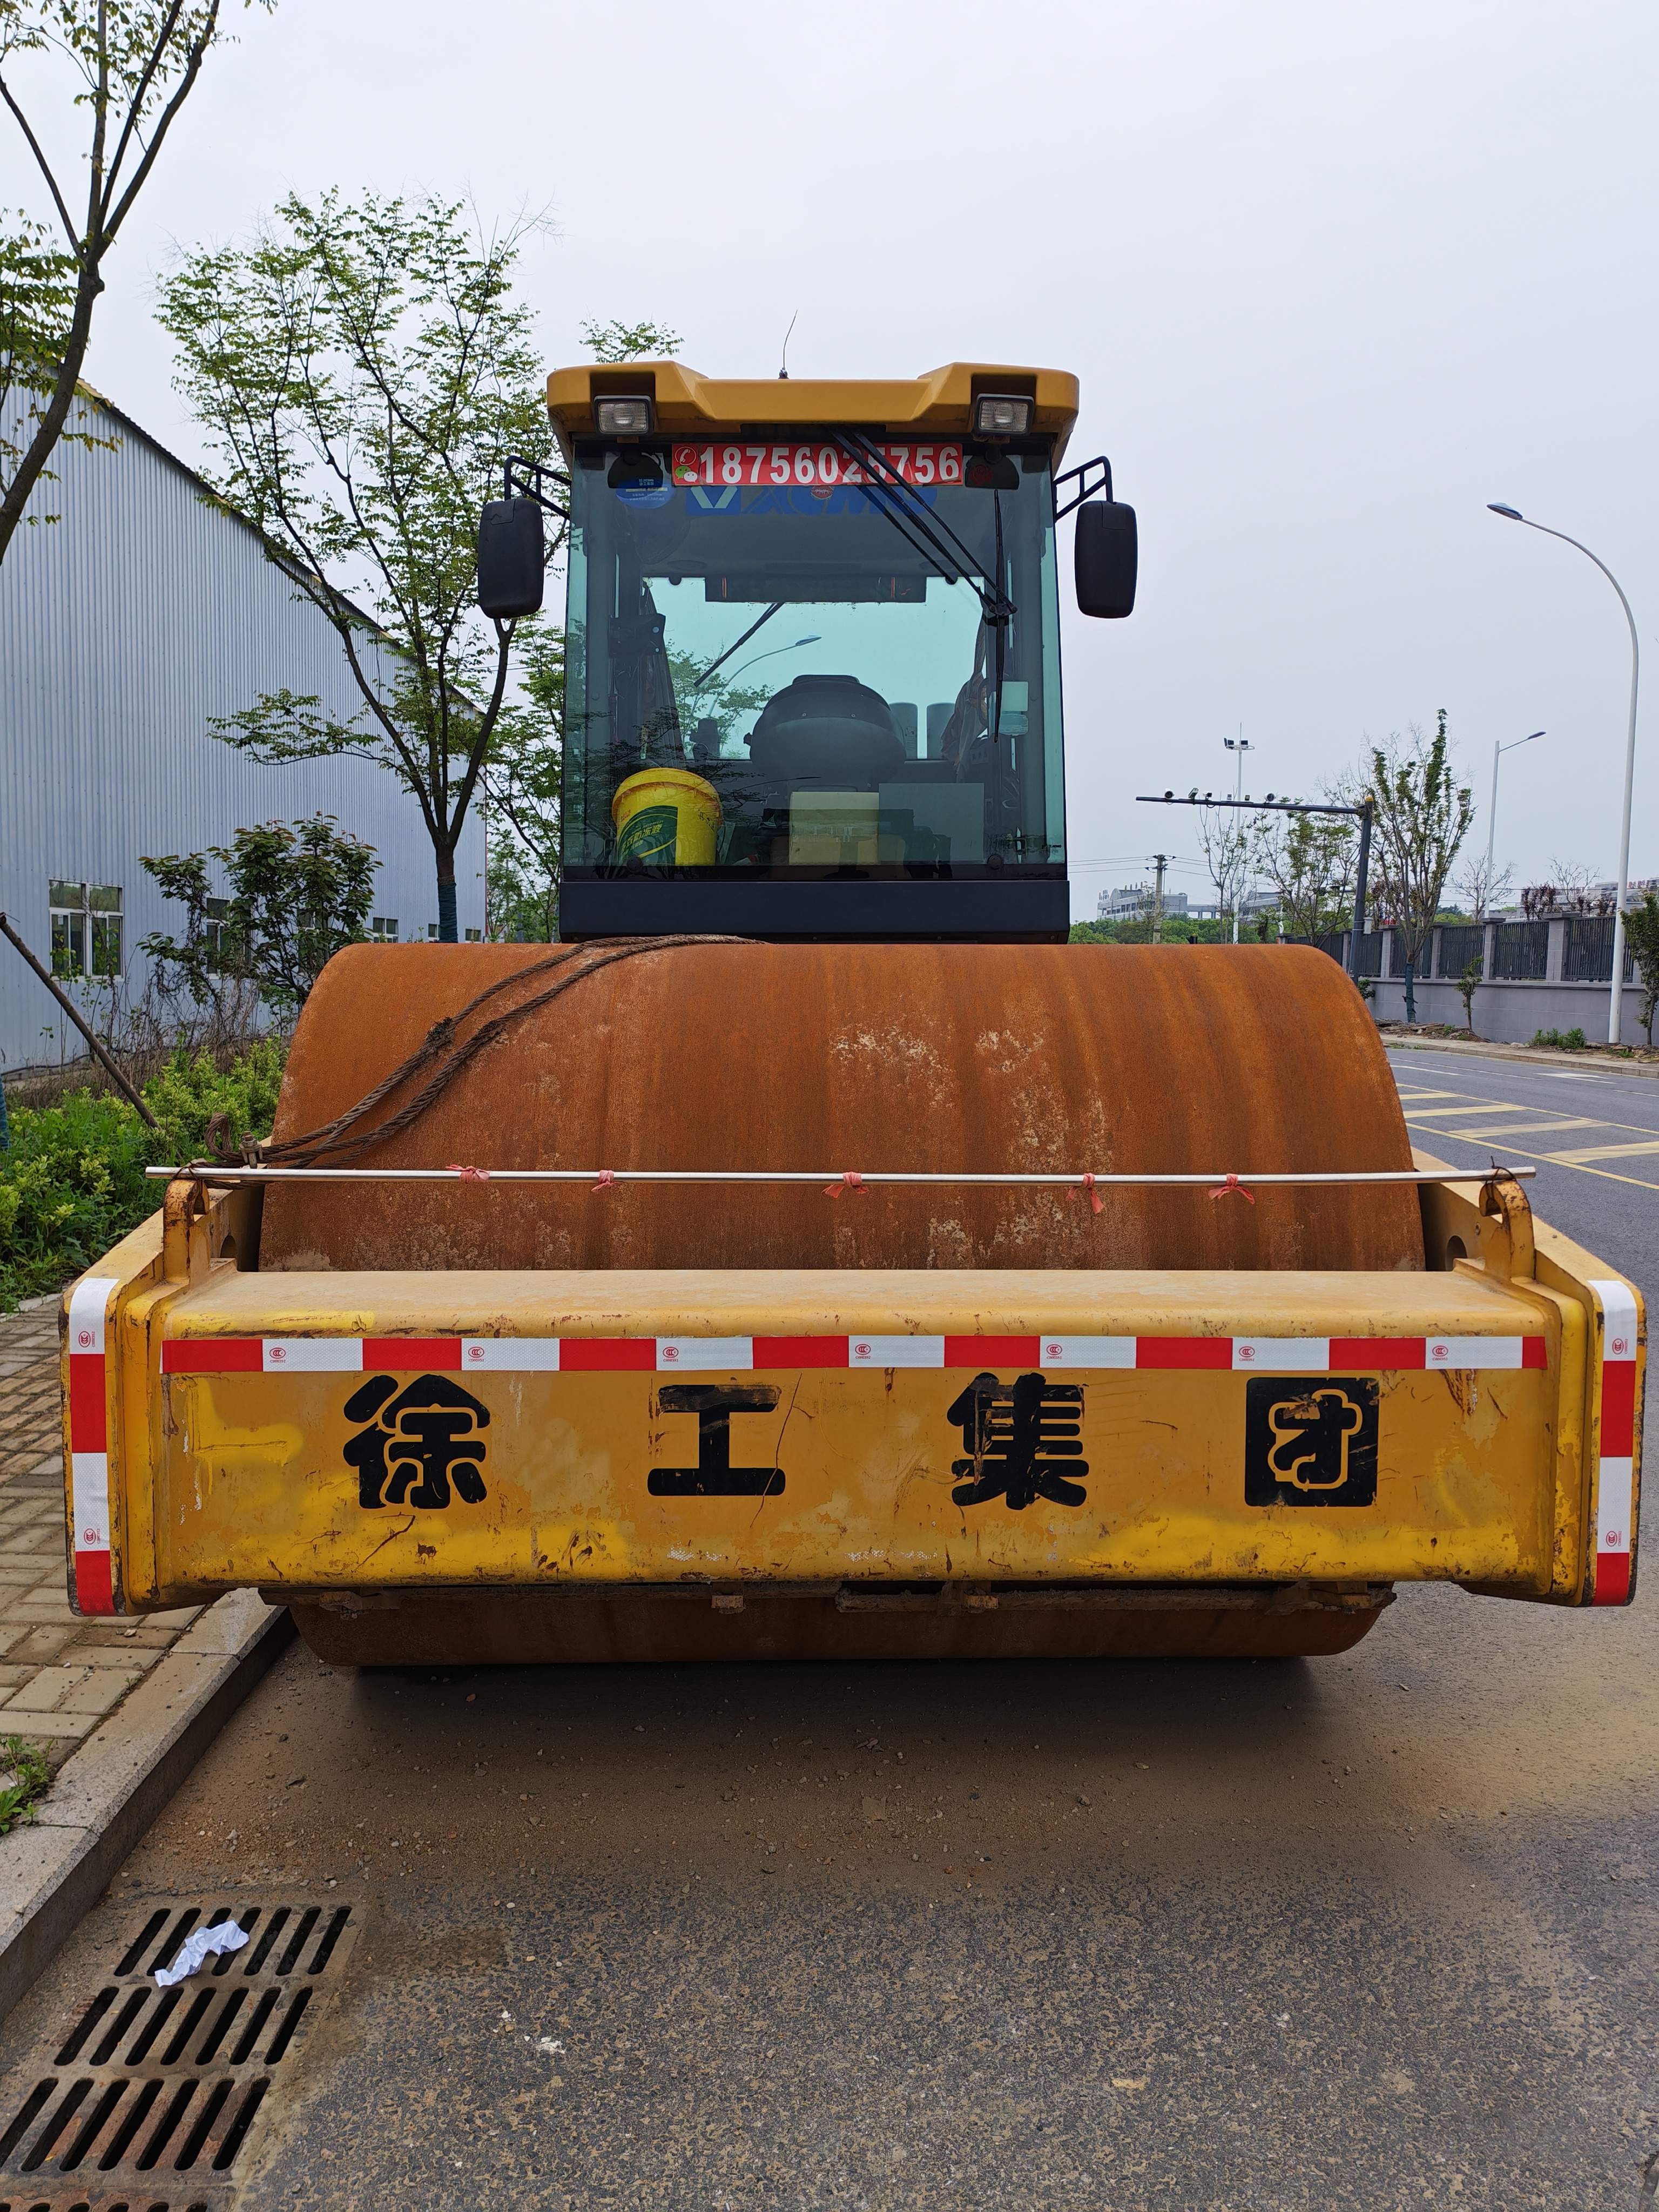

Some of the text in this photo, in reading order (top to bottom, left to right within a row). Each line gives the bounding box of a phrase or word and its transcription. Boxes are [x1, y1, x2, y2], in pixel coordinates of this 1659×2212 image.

[700, 446, 960, 484] 18756025756
[343, 1372, 1378, 1510] 徐工集团
